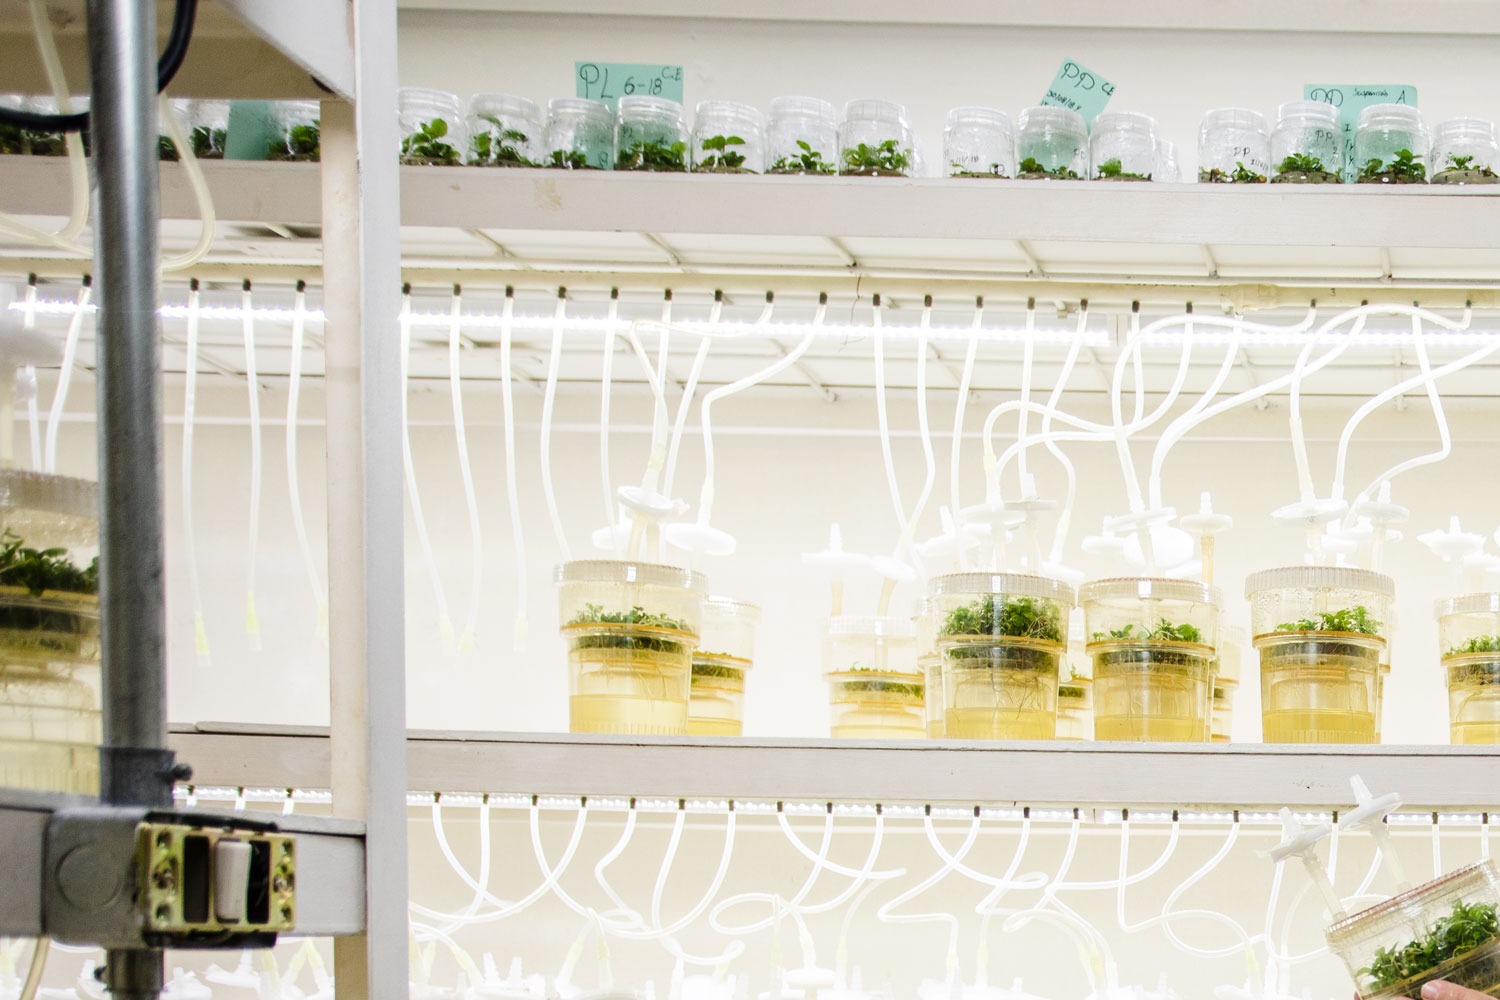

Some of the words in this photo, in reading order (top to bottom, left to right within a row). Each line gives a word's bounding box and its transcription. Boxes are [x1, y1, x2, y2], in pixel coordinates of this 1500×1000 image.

[580, 63, 614, 99] PL
[624, 76, 662, 96] 6-18
[1061, 62, 1096, 90] PP
[1395, 90, 1406, 105] A
